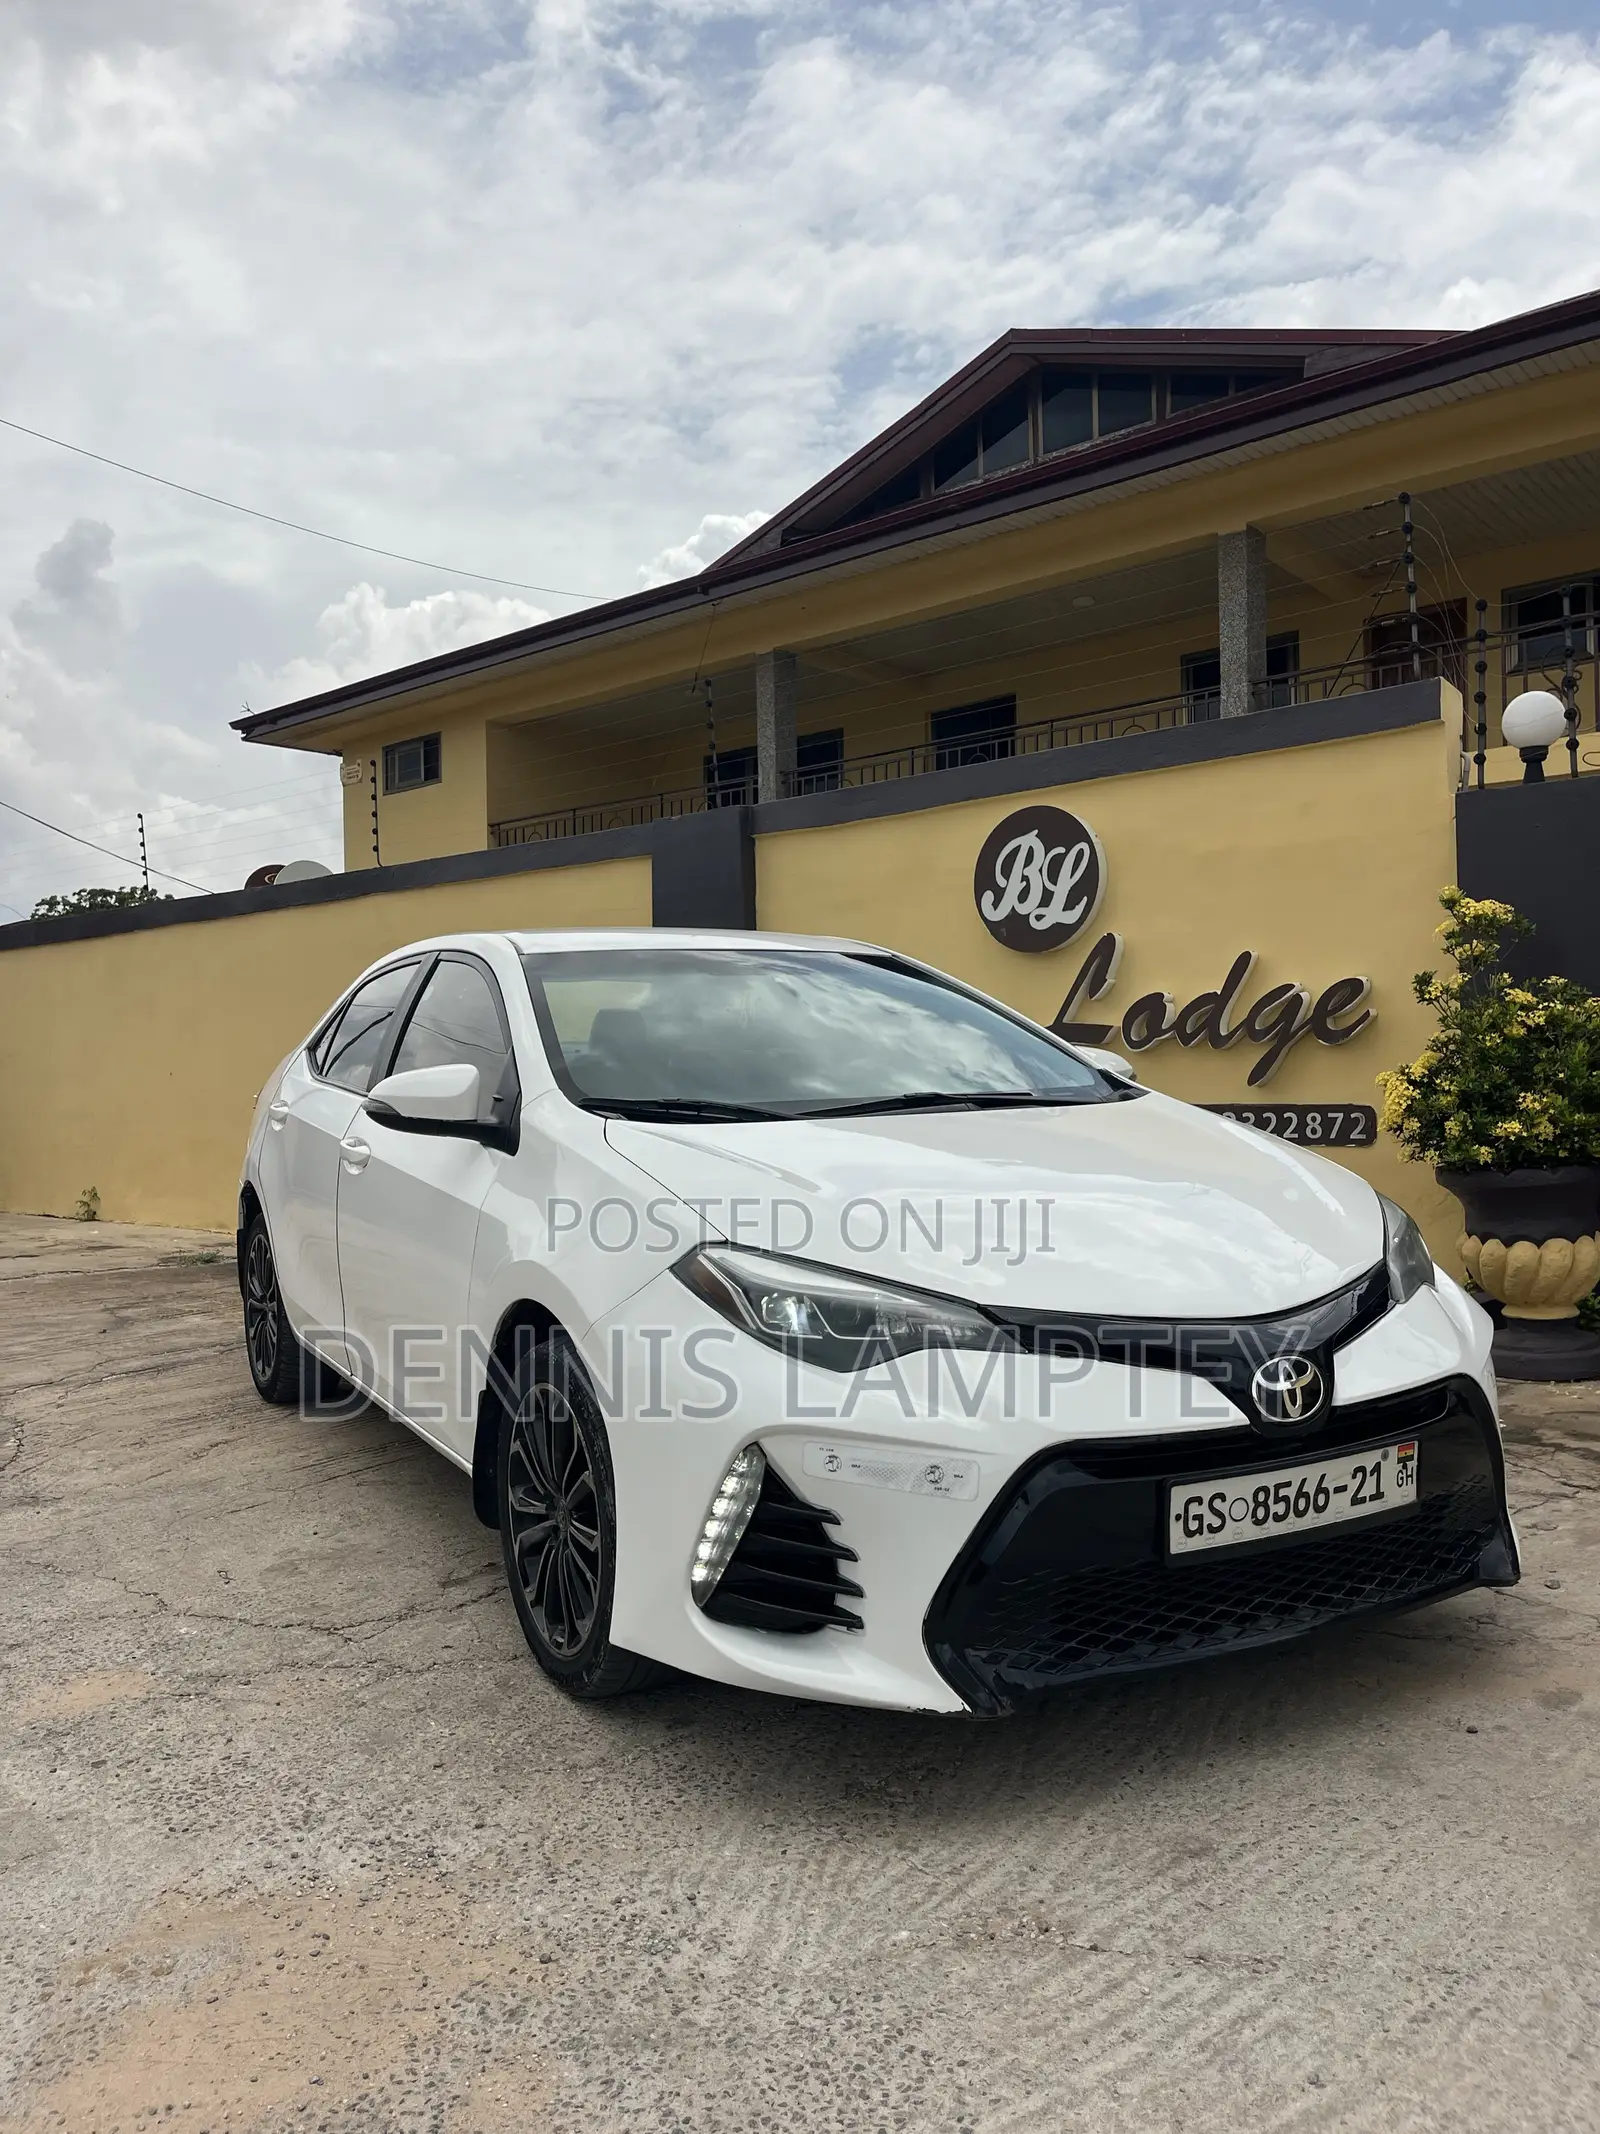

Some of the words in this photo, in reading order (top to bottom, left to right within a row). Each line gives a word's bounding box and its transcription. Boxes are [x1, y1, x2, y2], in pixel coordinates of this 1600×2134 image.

[980, 829, 1091, 931] BL
[1046, 932, 1378, 1088] Lodge
[1222, 1111, 1367, 1140] 22872
[1182, 1491, 1227, 1538] GS
[1251, 1460, 1385, 1526] 8566-21
[1396, 1467, 1414, 1489] GH
